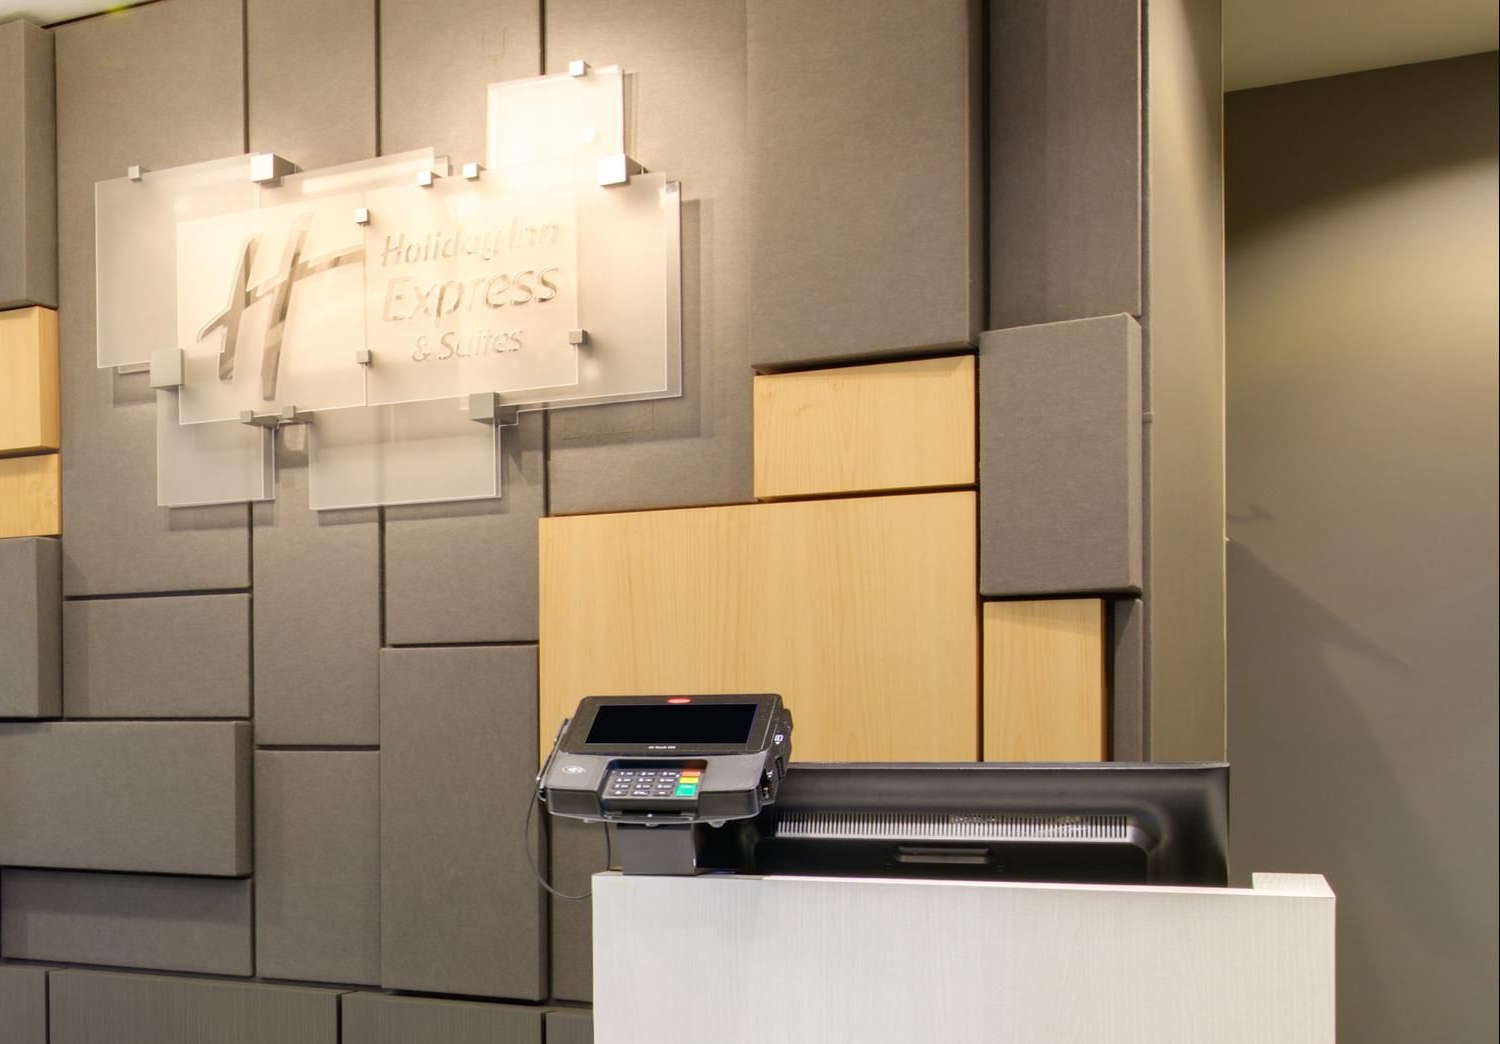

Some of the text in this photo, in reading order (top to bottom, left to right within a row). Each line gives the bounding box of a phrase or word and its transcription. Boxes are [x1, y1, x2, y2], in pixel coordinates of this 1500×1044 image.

[381, 215, 560, 267] Holiday Inn
[383, 267, 559, 329] Express
[411, 329, 524, 362] & Suites
